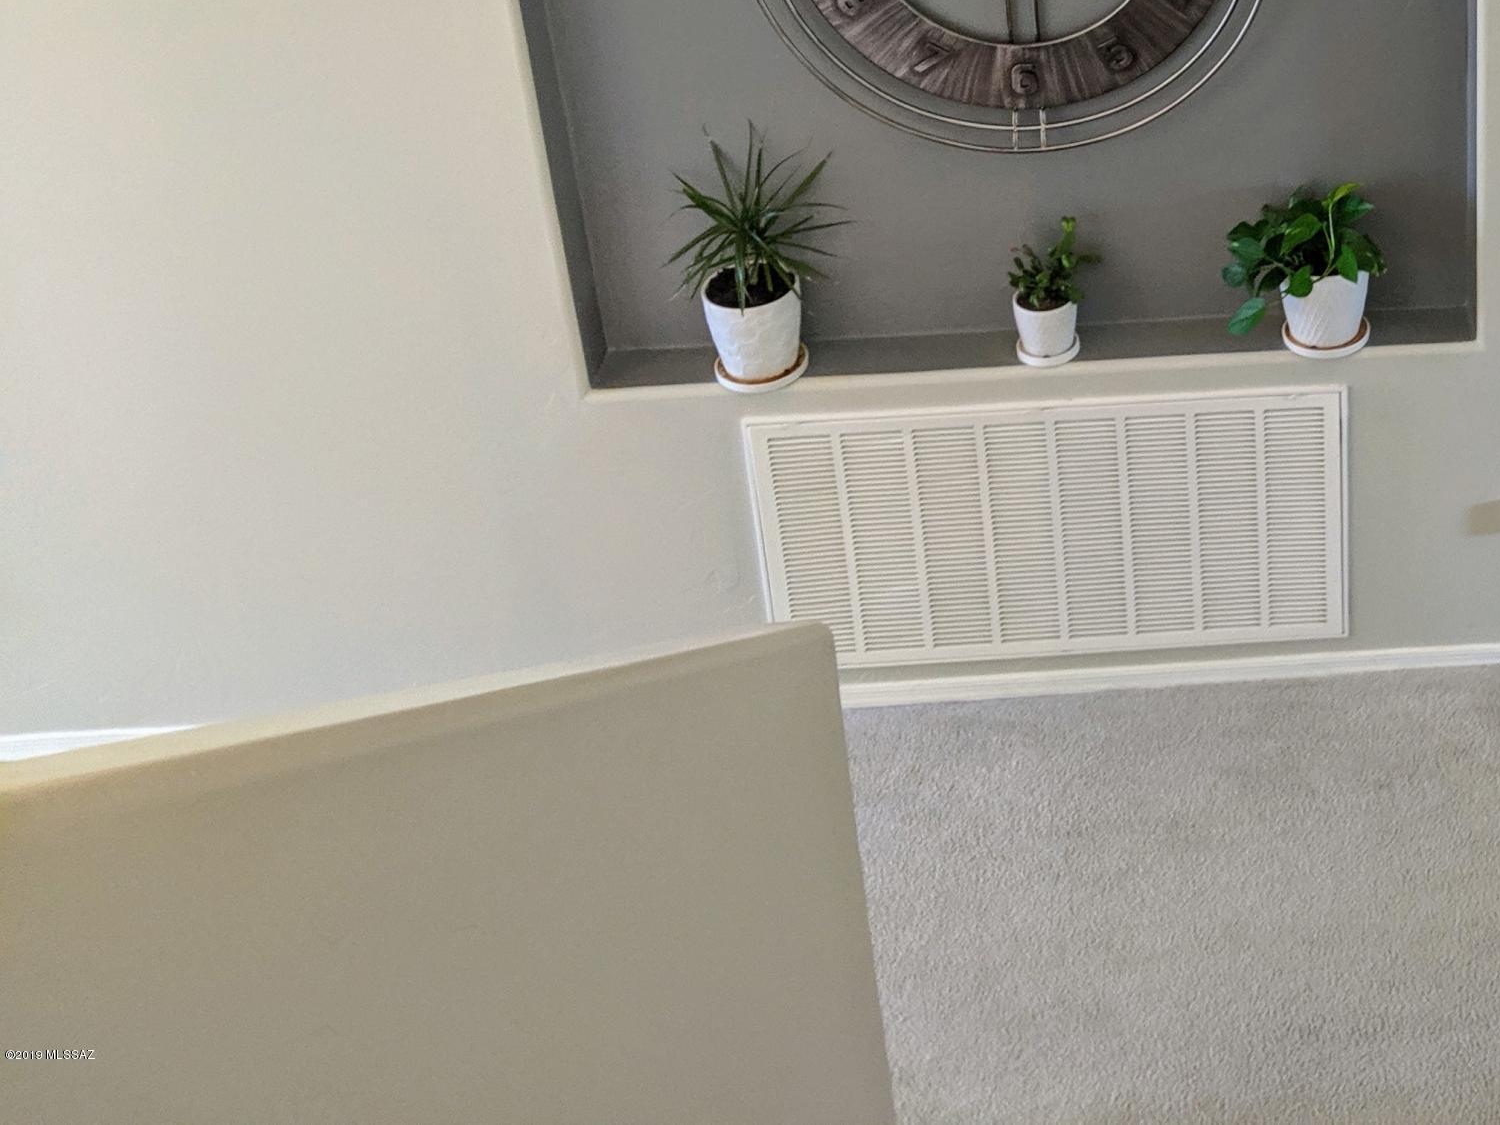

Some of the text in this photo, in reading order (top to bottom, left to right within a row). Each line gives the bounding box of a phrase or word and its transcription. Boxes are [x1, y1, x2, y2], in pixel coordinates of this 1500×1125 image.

[914, 41, 955, 74] 7
[1098, 36, 1136, 70] 5
[1009, 62, 1040, 94] 6
